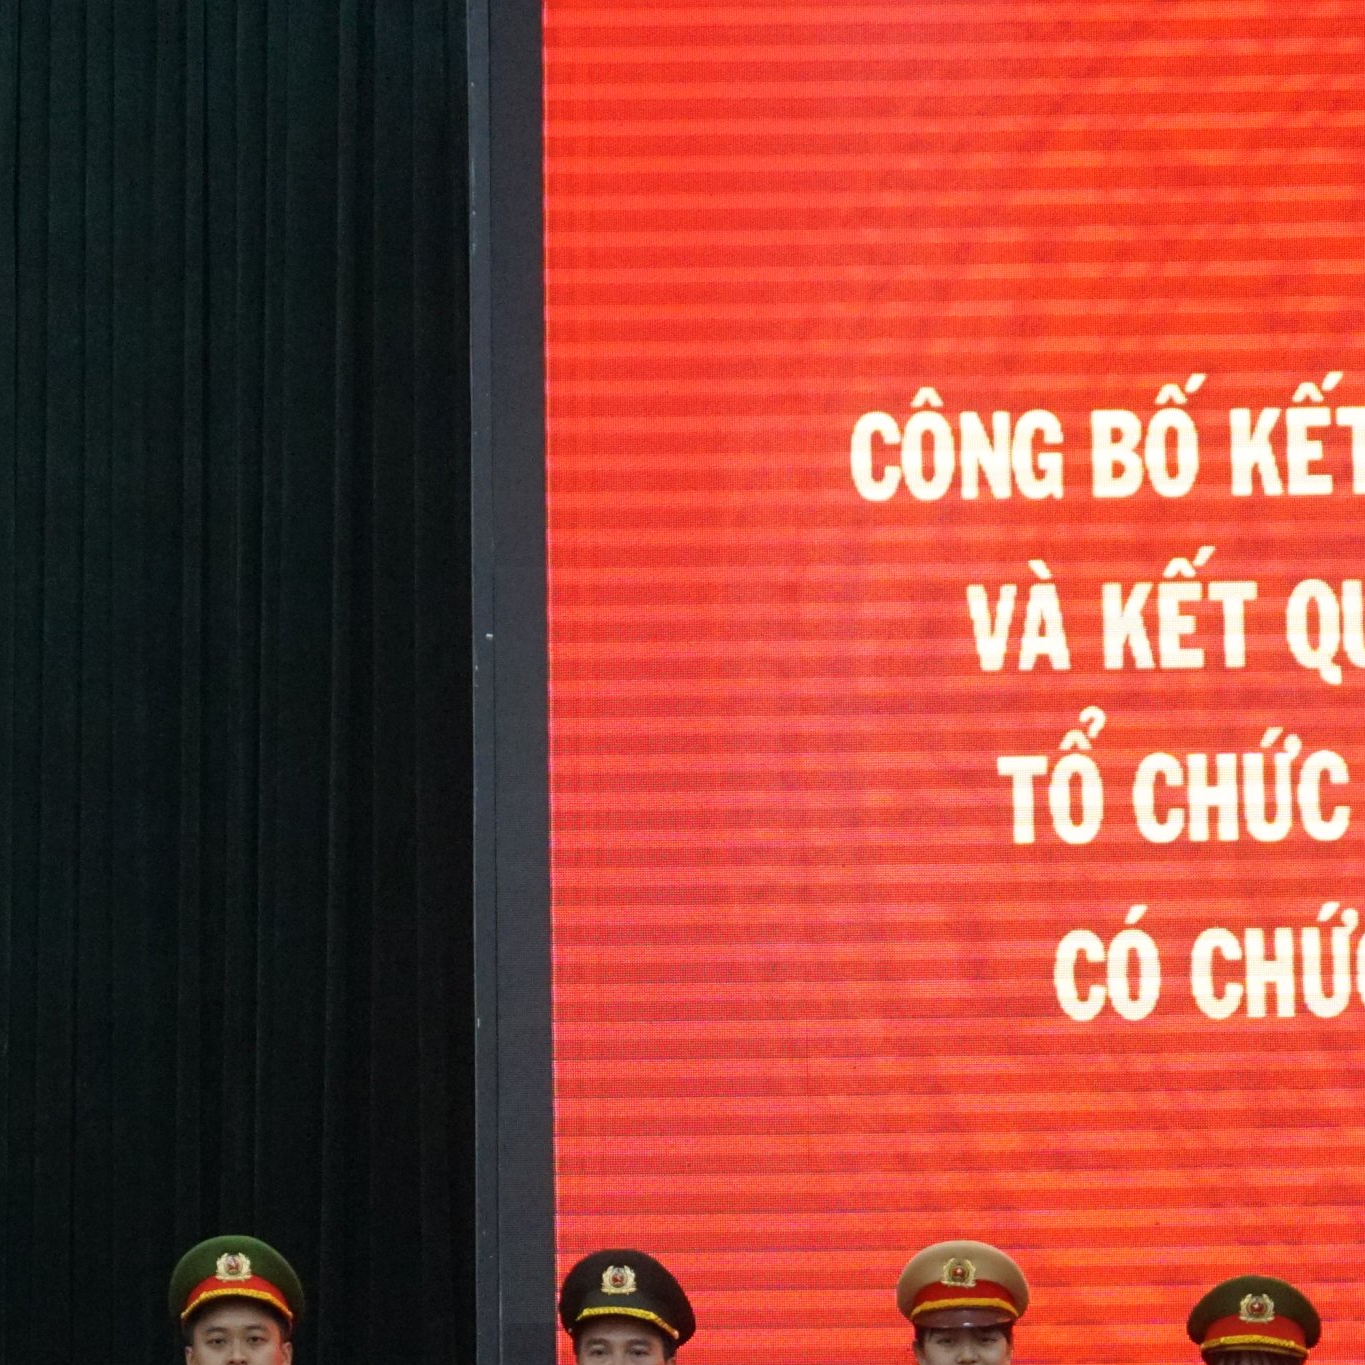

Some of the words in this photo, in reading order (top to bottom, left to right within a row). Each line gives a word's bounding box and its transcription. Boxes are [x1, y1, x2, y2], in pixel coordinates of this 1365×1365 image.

[850, 387, 1064, 502] CÔNG
[1090, 373, 1206, 498] BỐ
[967, 560, 1071, 672] VÀ
[1101, 546, 1257, 670] KẾT
[995, 706, 1106, 844] TỔ
[1132, 727, 1350, 843] CHỨC
[1053, 904, 1162, 1022] CÓ
